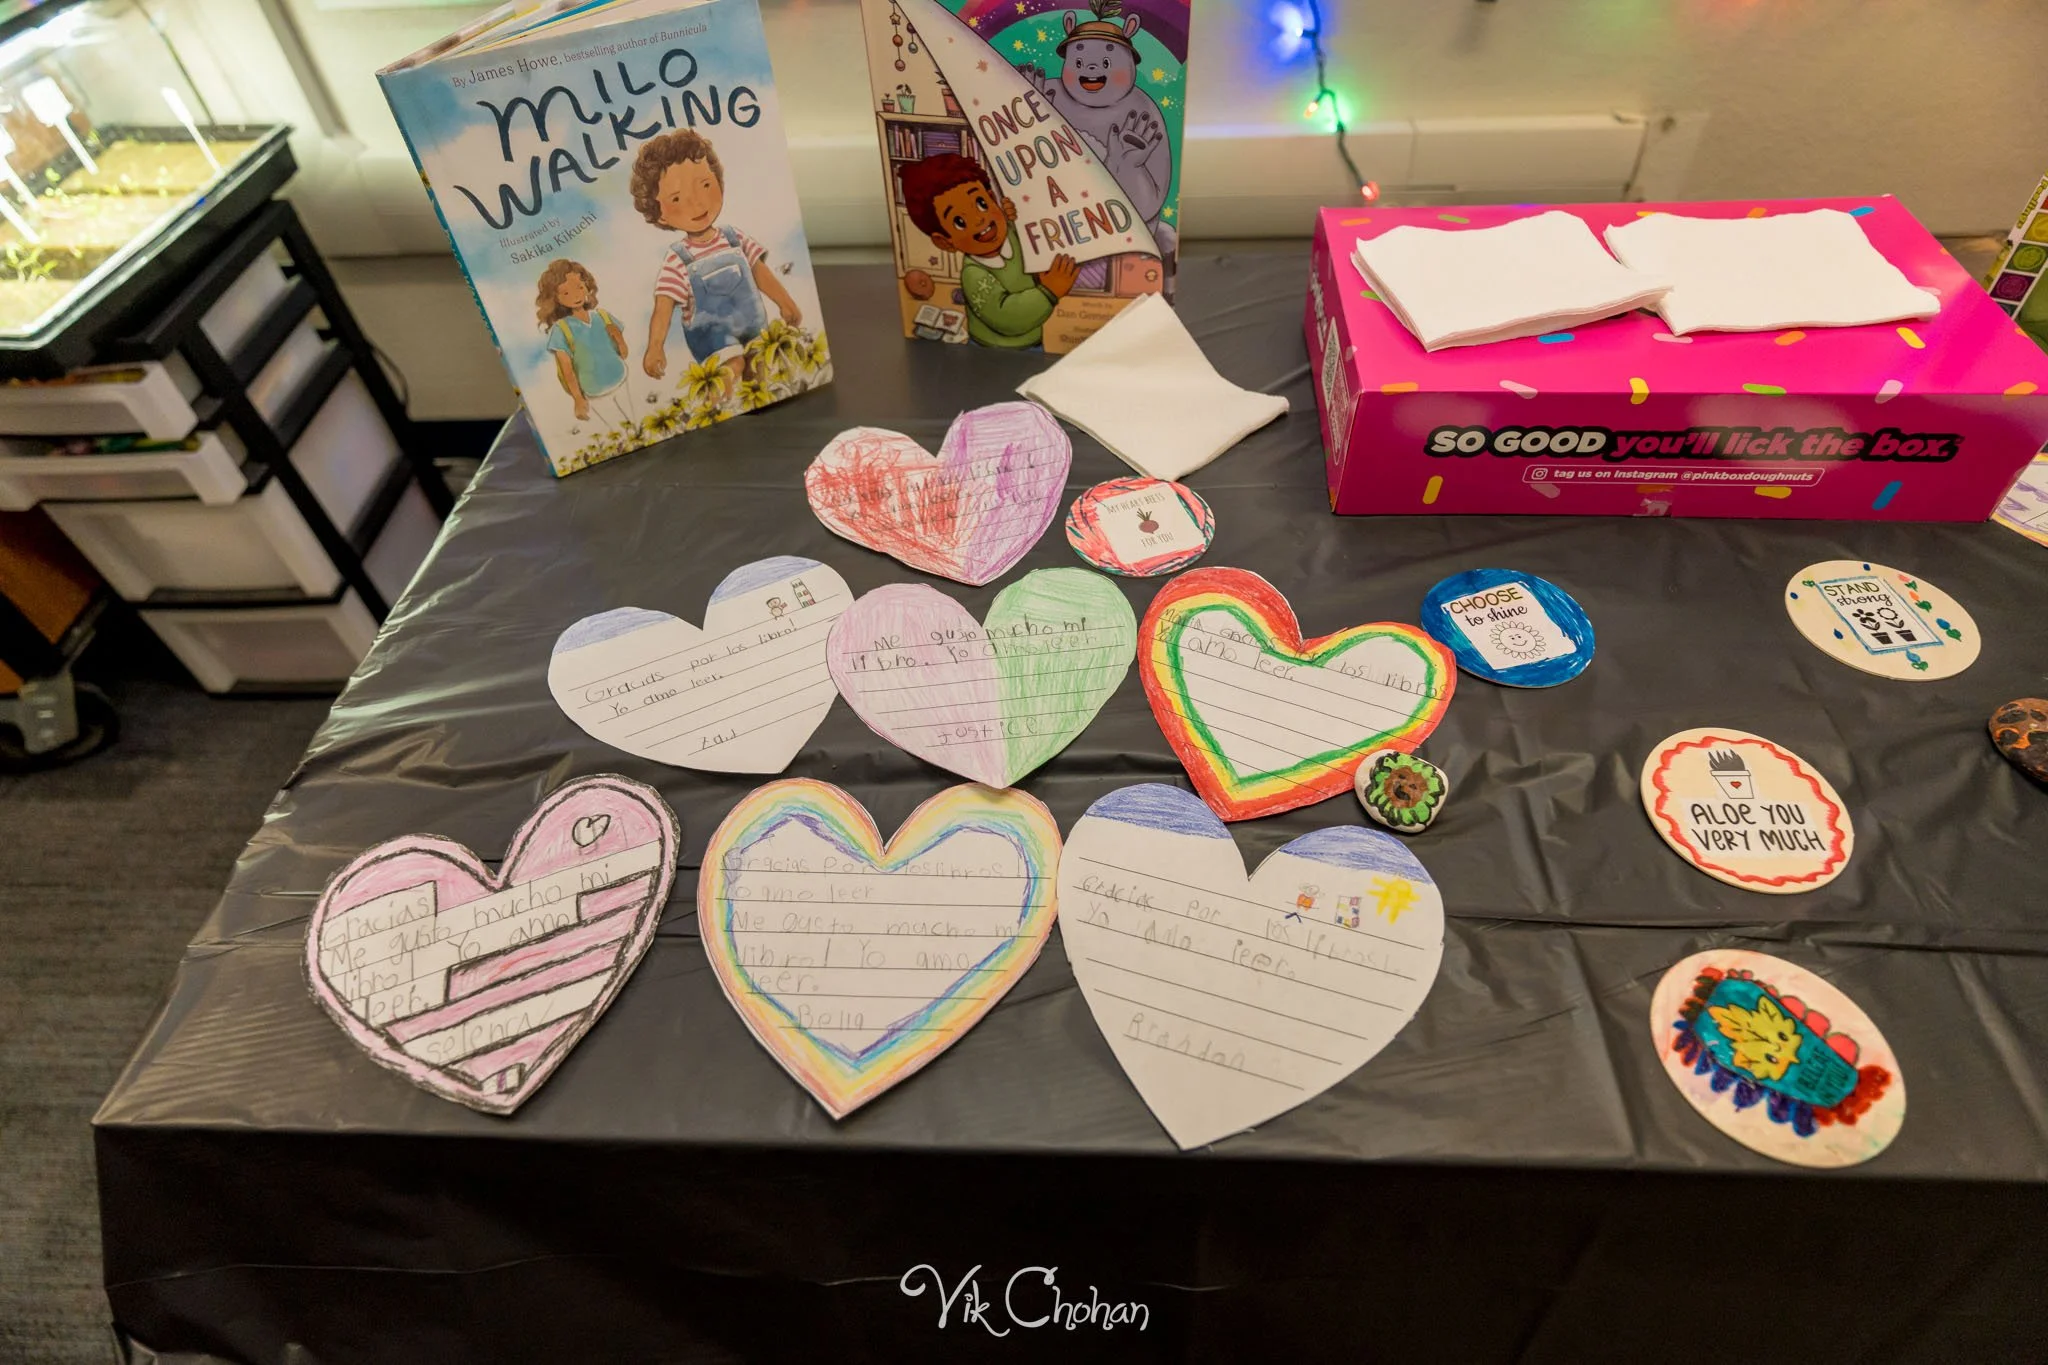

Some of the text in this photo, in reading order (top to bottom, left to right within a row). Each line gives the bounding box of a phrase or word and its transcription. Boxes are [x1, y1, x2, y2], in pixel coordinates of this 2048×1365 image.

[452, 23, 708, 88] By James Howe, bestselling author of Bunnicula
[477, 48, 698, 162] MILO
[978, 90, 1050, 147] ONCE
[453, 84, 762, 230] WALKING
[995, 124, 1084, 186] UPON
[1046, 175, 1069, 207] A
[500, 217, 561, 248] Illustrated by
[510, 211, 597, 265] Sakika Kikuchi
[1024, 198, 1133, 255] FRIEND
[1431, 430, 1486, 453] SO
[1494, 430, 1606, 453] GOOD
[1614, 431, 1719, 457] you'll
[1723, 432, 1795, 455] lick
[1799, 433, 1864, 455] the
[1554, 469, 1814, 481] tag us on Instagram @pinkboxdoughnuts
[1141, 532, 1174, 548] FOR YOU
[1450, 587, 1523, 614] CHOOSE
[1825, 581, 1880, 597] STAND
[1837, 591, 1893, 607] strong
[1465, 605, 1528, 627] to shine
[874, 635, 901, 652] Me
[584, 671, 666, 704] Gracias
[608, 702, 629, 718] Yo
[643, 688, 677, 706] amo
[1762, 803, 1807, 825] YOU
[1761, 829, 1826, 852] MUCH
[331, 942, 366, 977] Me
[474, 880, 561, 928] mucho
[732, 910, 765, 931] Me
[447, 930, 481, 962] Yo
[509, 913, 570, 945] amo
[859, 938, 886, 968] Yo
